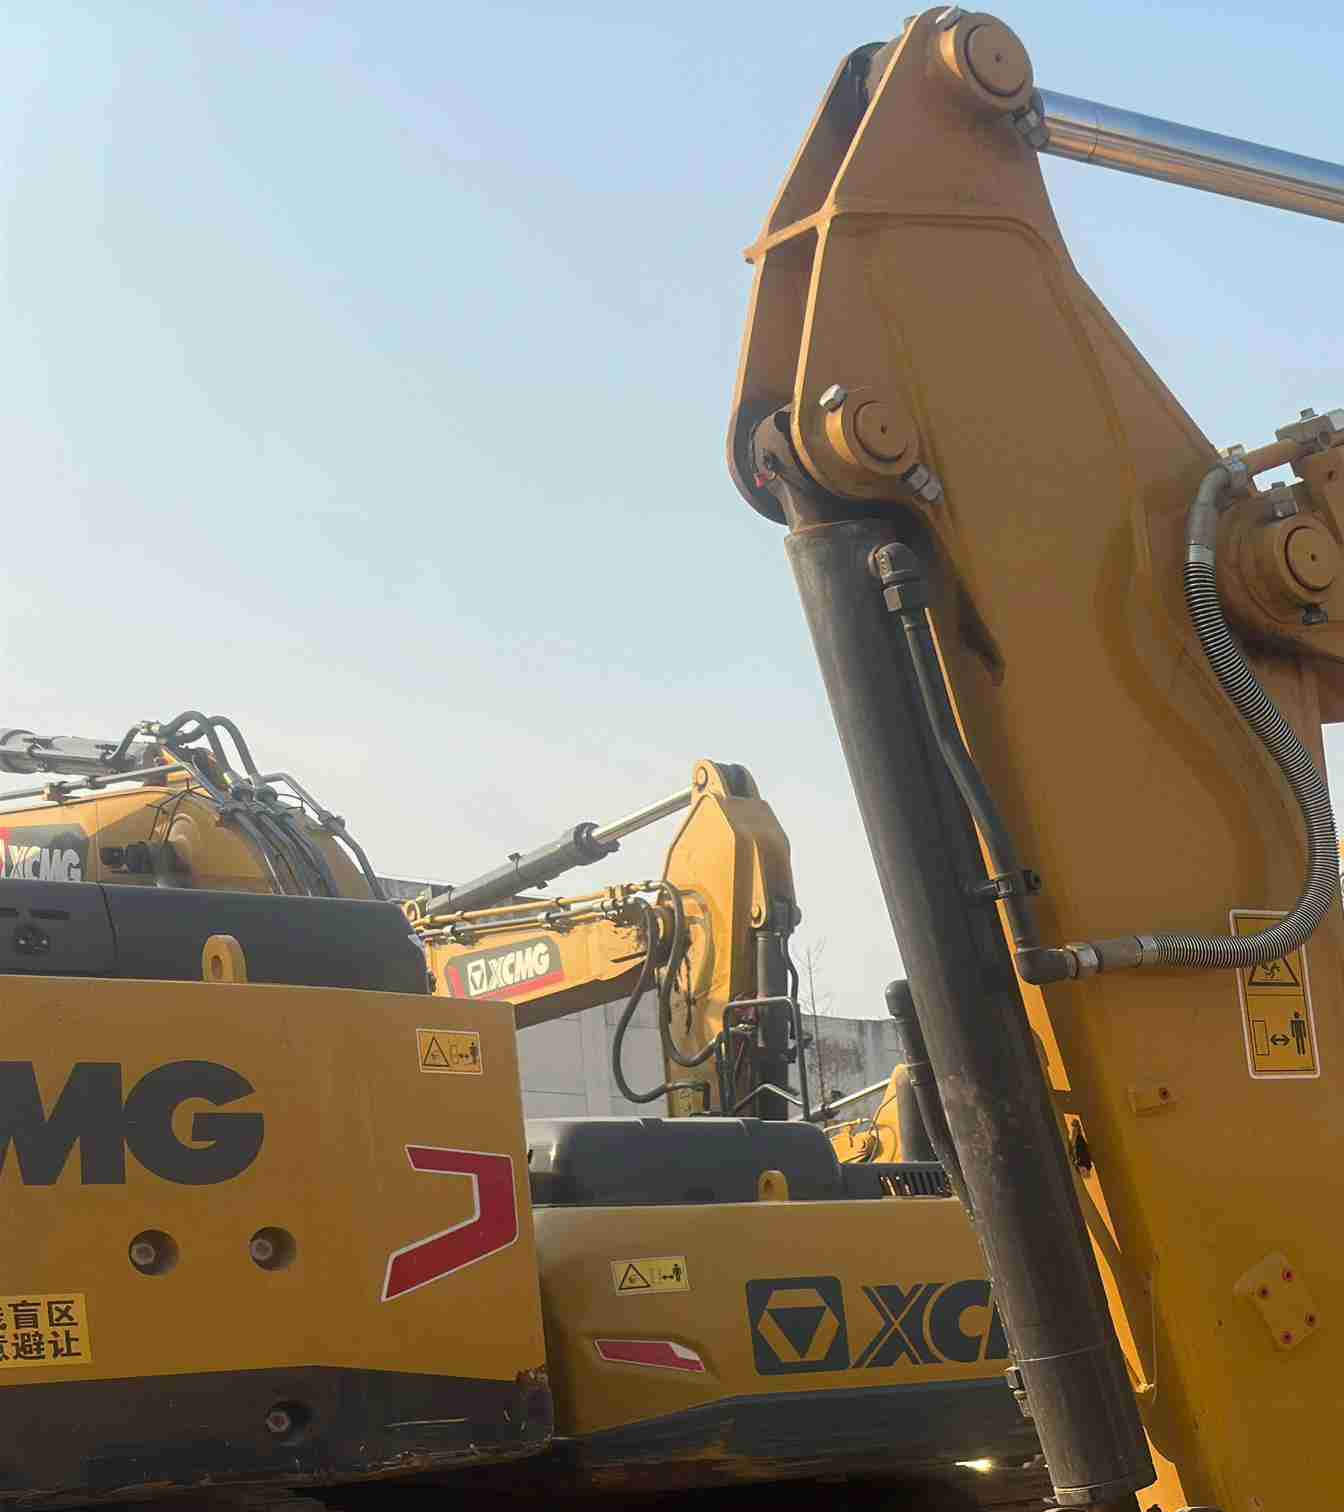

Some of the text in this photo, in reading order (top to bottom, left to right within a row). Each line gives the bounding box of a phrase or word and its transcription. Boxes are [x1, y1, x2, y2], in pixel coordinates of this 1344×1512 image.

[8, 845, 81, 881] XCMG
[487, 942, 551, 993] XCMG
[850, 1279, 1011, 1366] XC
